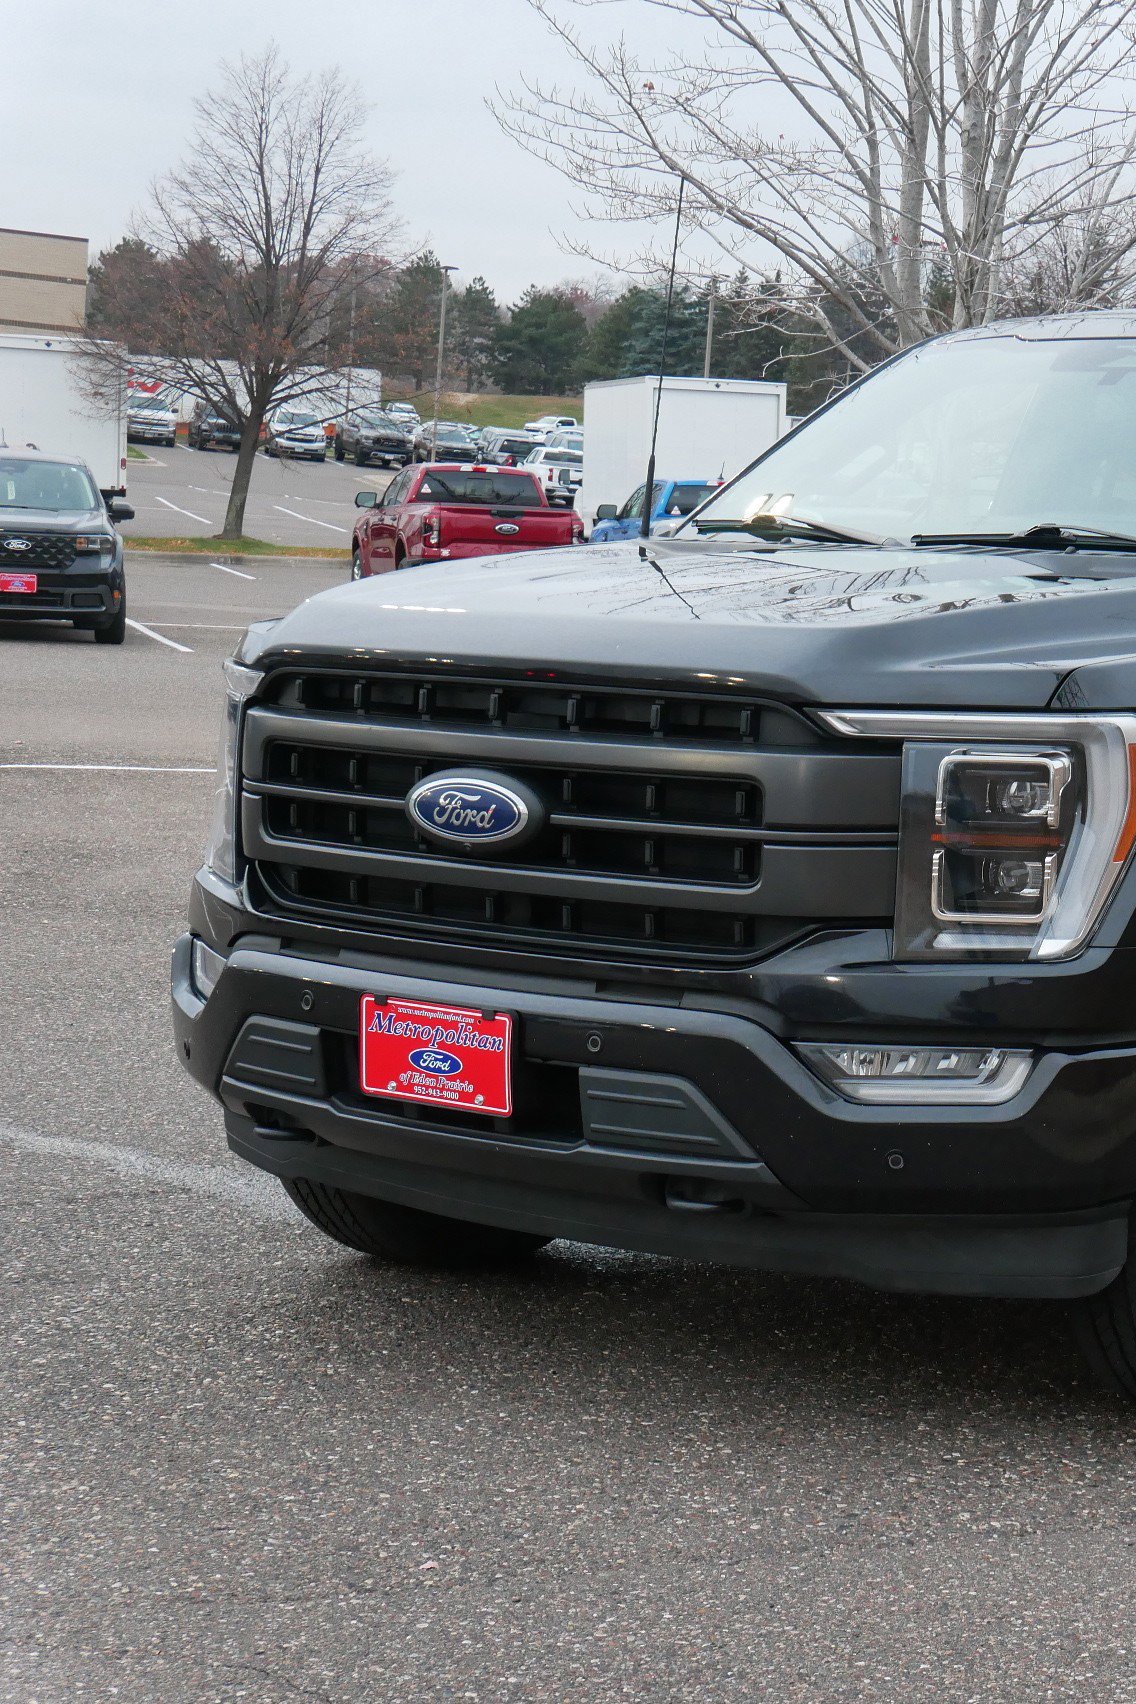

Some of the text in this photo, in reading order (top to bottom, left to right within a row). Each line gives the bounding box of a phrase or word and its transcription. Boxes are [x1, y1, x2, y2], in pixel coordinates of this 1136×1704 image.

[433, 790, 497, 829] Ford
[368, 1010, 504, 1052] Metropolitan
[419, 1052, 451, 1072] Ford
[399, 1071, 474, 1093] of Eden Prairie
[413, 1085, 459, 1100] 952-943-9000
